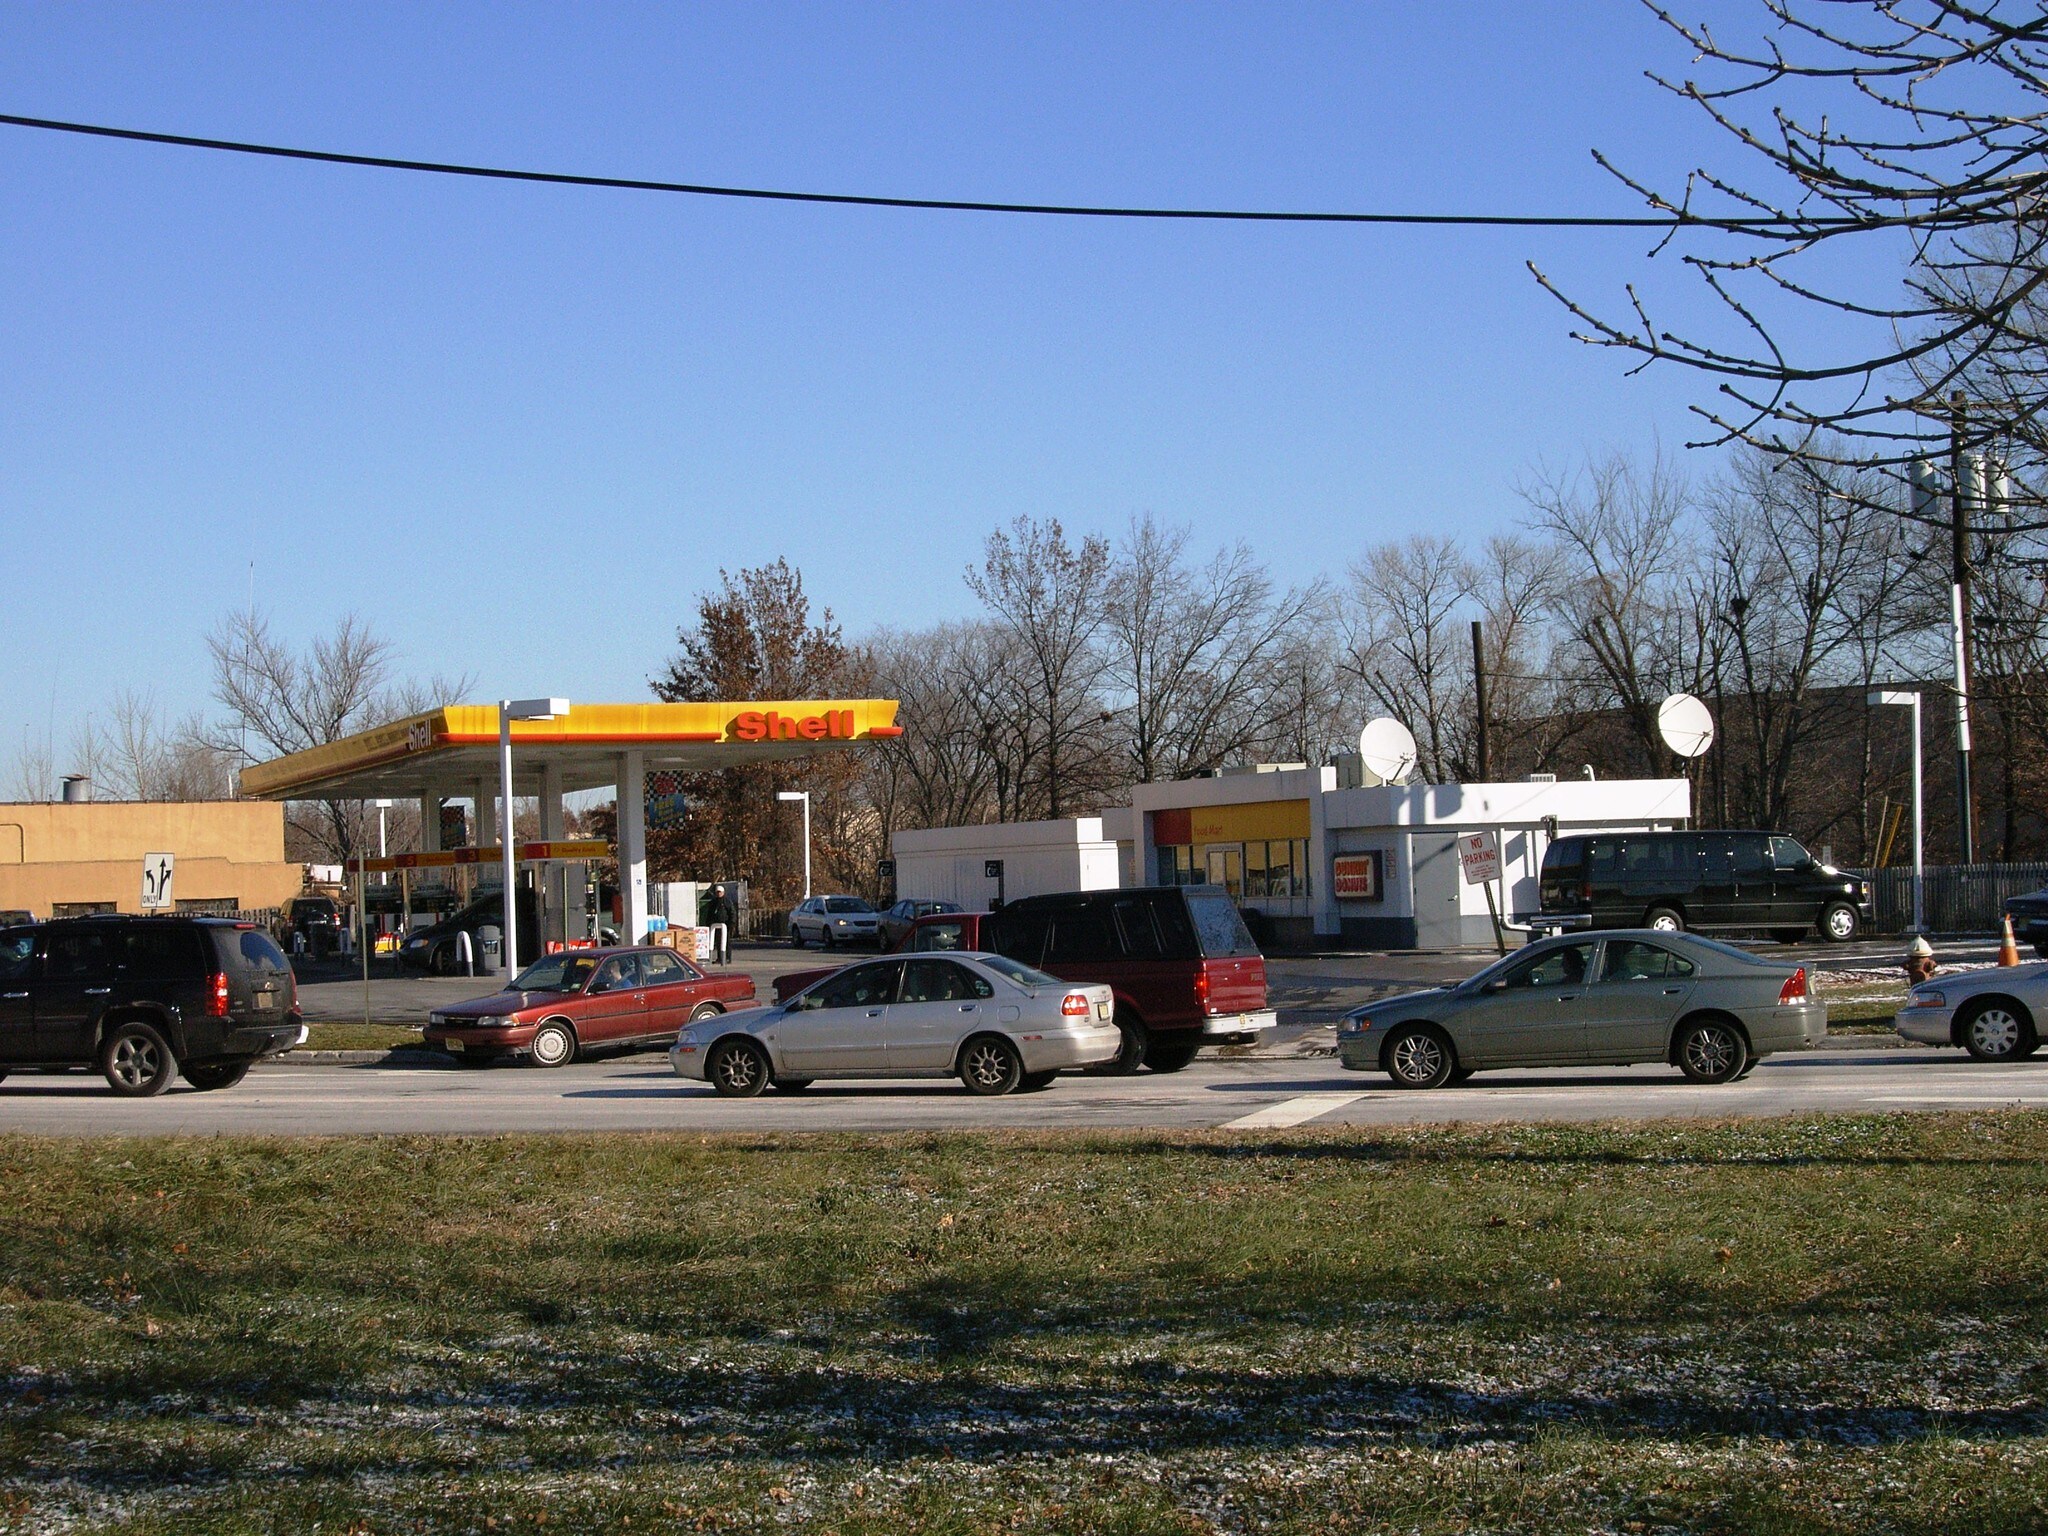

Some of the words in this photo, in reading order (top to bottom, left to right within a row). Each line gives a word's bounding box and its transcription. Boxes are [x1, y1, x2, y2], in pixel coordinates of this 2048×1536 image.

[736, 709, 855, 740] Shell
[408, 719, 431, 750] Shell
[541, 845, 549, 857] 1
[1470, 837, 1483, 850] NO
[1464, 849, 1496, 866] PARKING
[1335, 876, 1368, 893] DONUTS
[142, 894, 157, 904] ONLY
